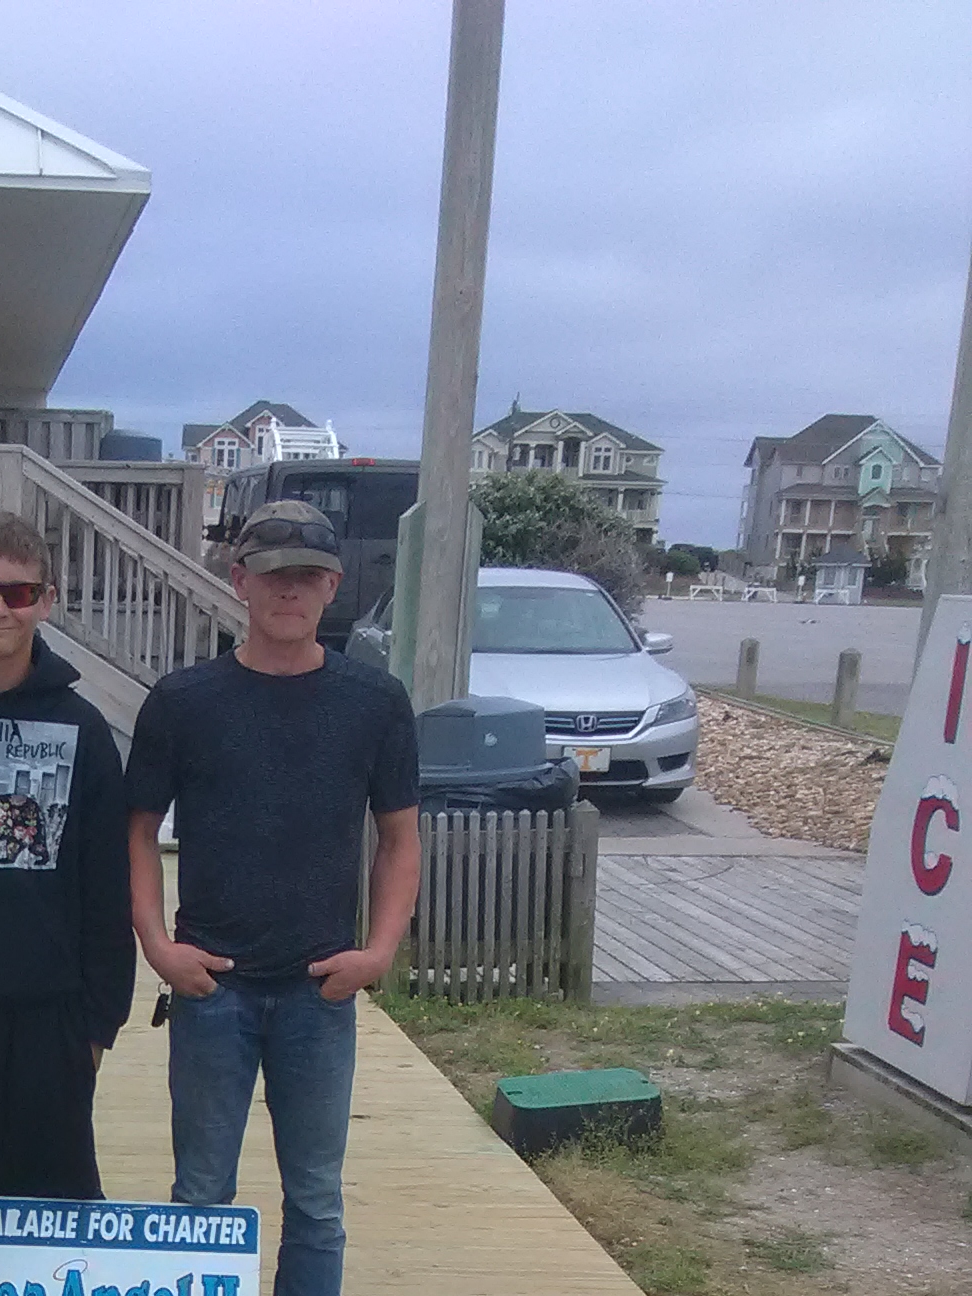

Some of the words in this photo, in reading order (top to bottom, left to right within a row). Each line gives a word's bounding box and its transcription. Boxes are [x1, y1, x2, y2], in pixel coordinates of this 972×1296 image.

[6, 741, 67, 760] REPUBLIC
[88, 1211, 133, 1241] FOR
[144, 1215, 247, 1245] CHARTER
